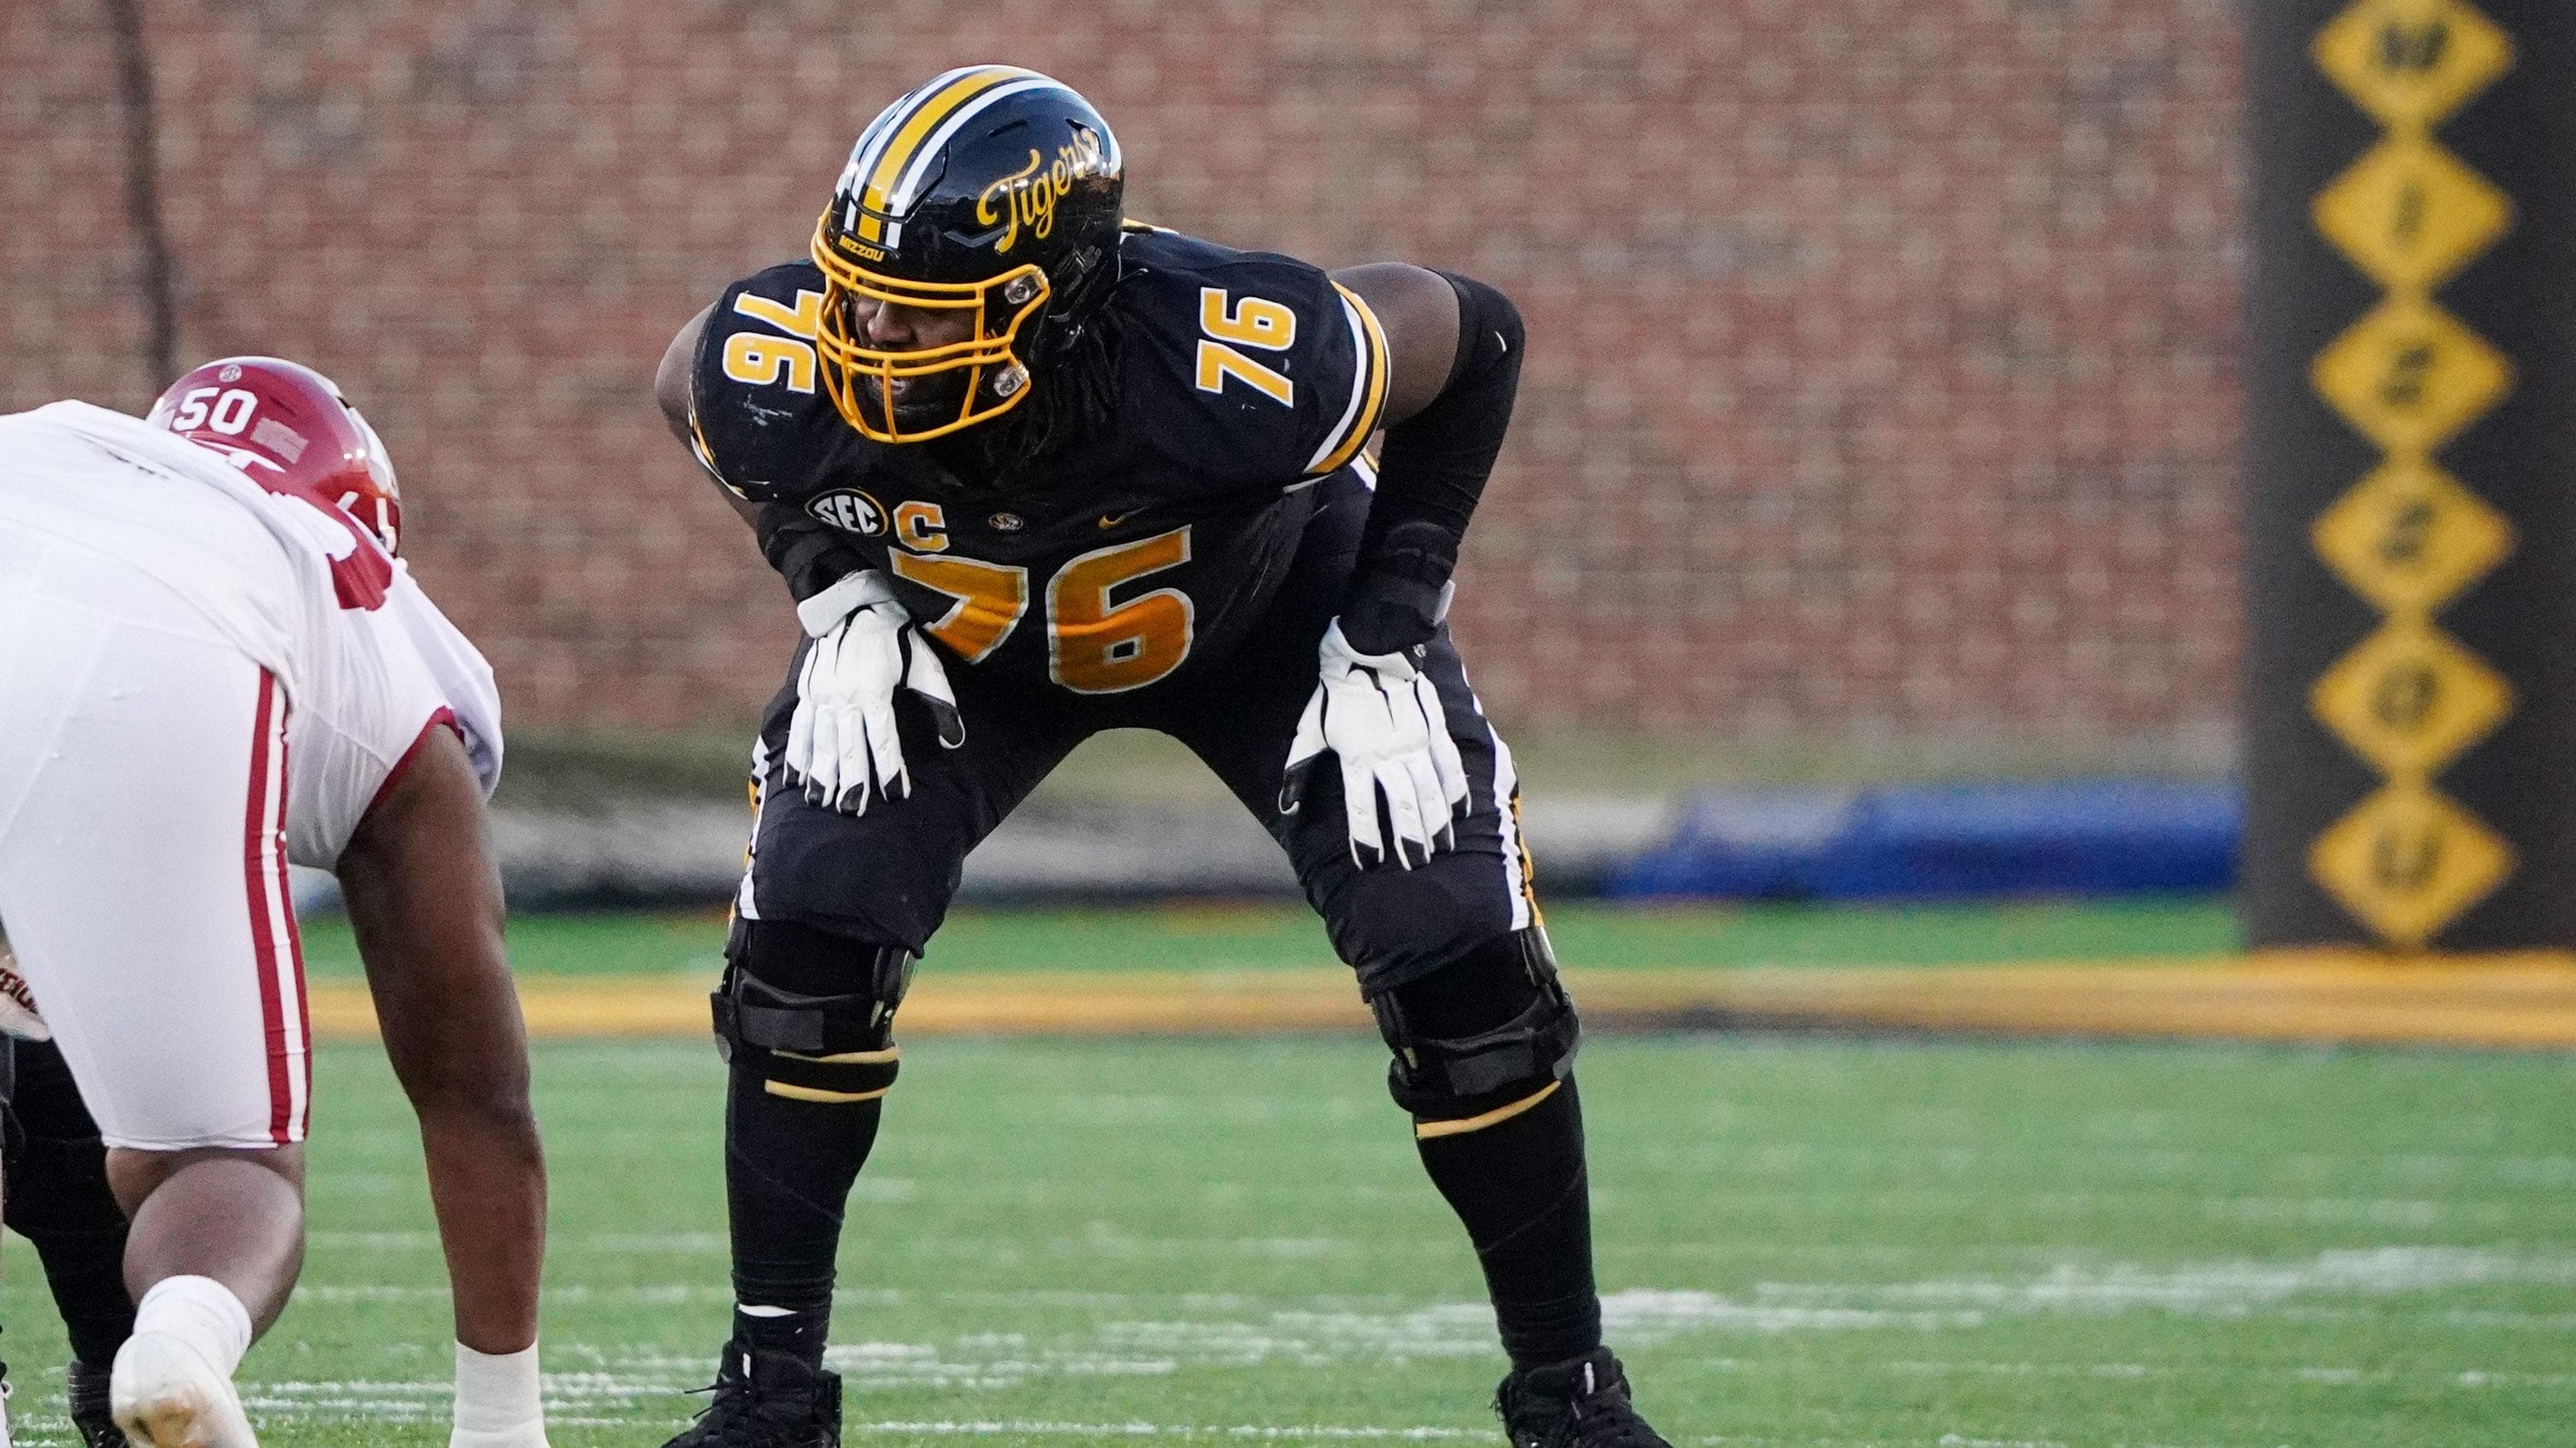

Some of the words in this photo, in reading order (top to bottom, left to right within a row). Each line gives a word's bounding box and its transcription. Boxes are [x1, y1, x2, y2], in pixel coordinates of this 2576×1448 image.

[976, 127, 1100, 253] Tigers
[838, 234, 885, 262] MIZZOU
[723, 289, 823, 394] 76
[1195, 286, 1296, 408] 76
[172, 387, 258, 435] 50
[813, 495, 878, 533] SEC
[892, 500, 950, 552] C
[888, 524, 1195, 694] 76
